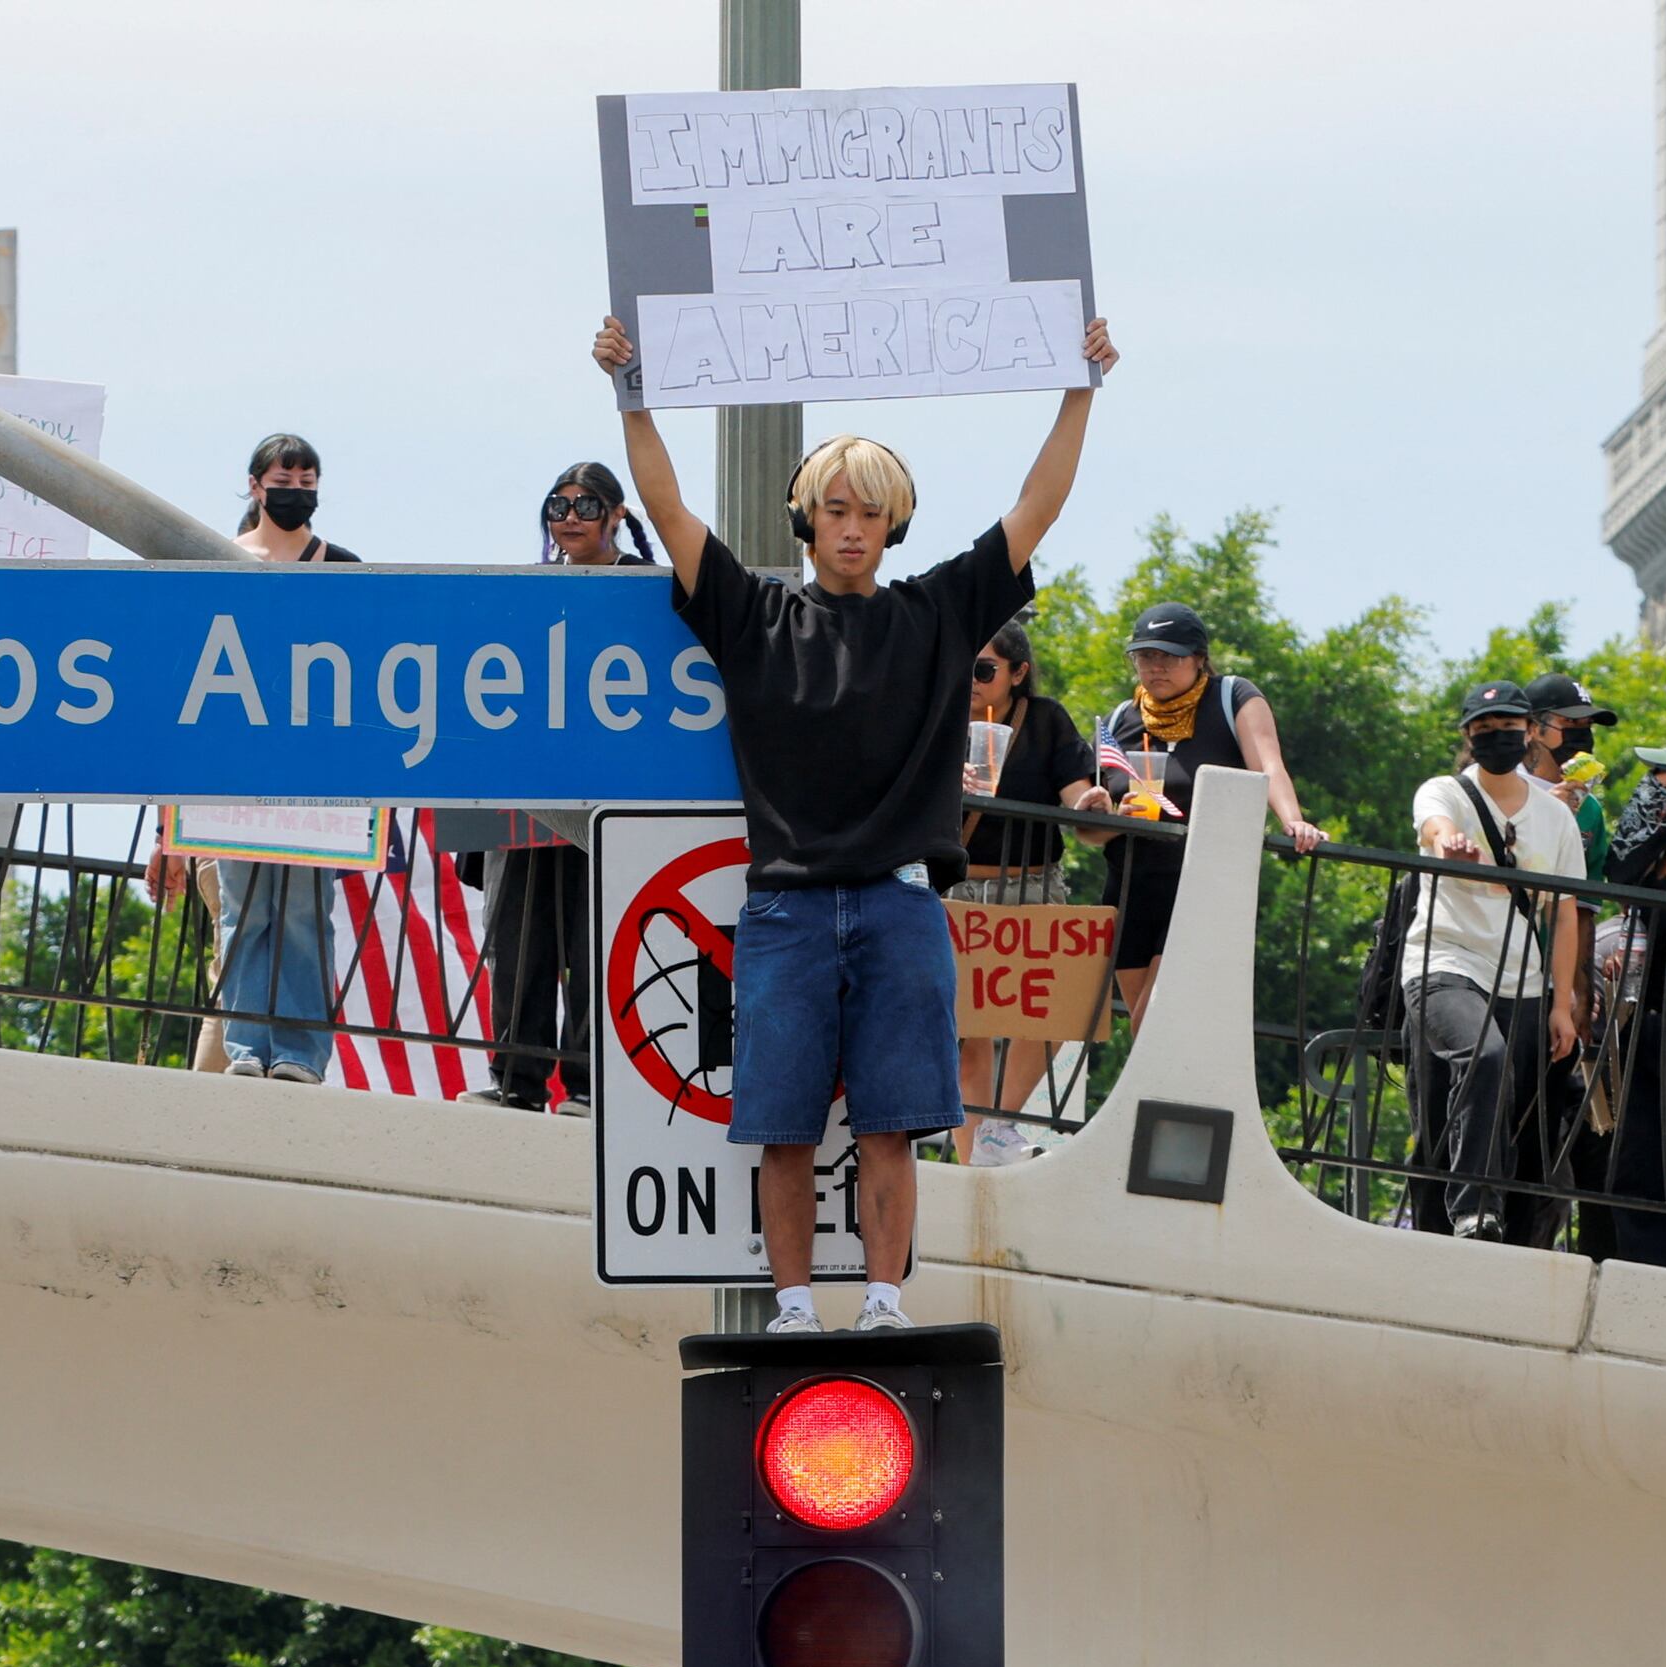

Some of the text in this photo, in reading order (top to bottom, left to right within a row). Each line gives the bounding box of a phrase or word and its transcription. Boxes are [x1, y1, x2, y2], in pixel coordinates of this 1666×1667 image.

[635, 106, 1065, 191] IMMIGRANTS
[738, 201, 945, 273] ARE
[658, 296, 1057, 390] AMERICA
[177, 615, 727, 770] Angeles
[972, 965, 1056, 1020] ICE
[626, 1165, 717, 1237] ON
